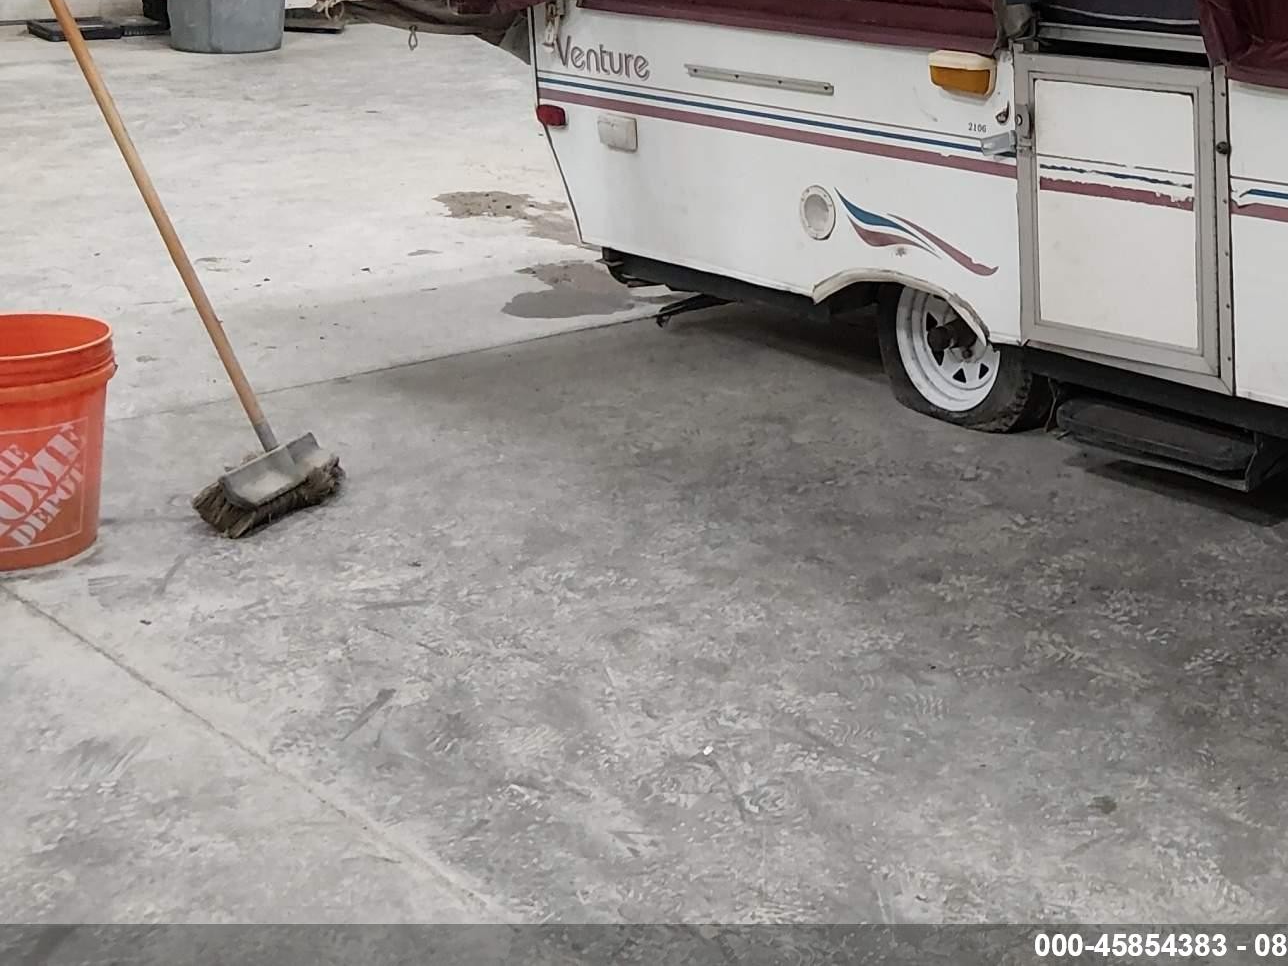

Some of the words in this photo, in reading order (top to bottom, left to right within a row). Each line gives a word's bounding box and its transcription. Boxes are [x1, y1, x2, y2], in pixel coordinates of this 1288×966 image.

[554, 35, 650, 81] Venture
[0, 424, 86, 535] OME
[10, 462, 85, 546] DEPOT
